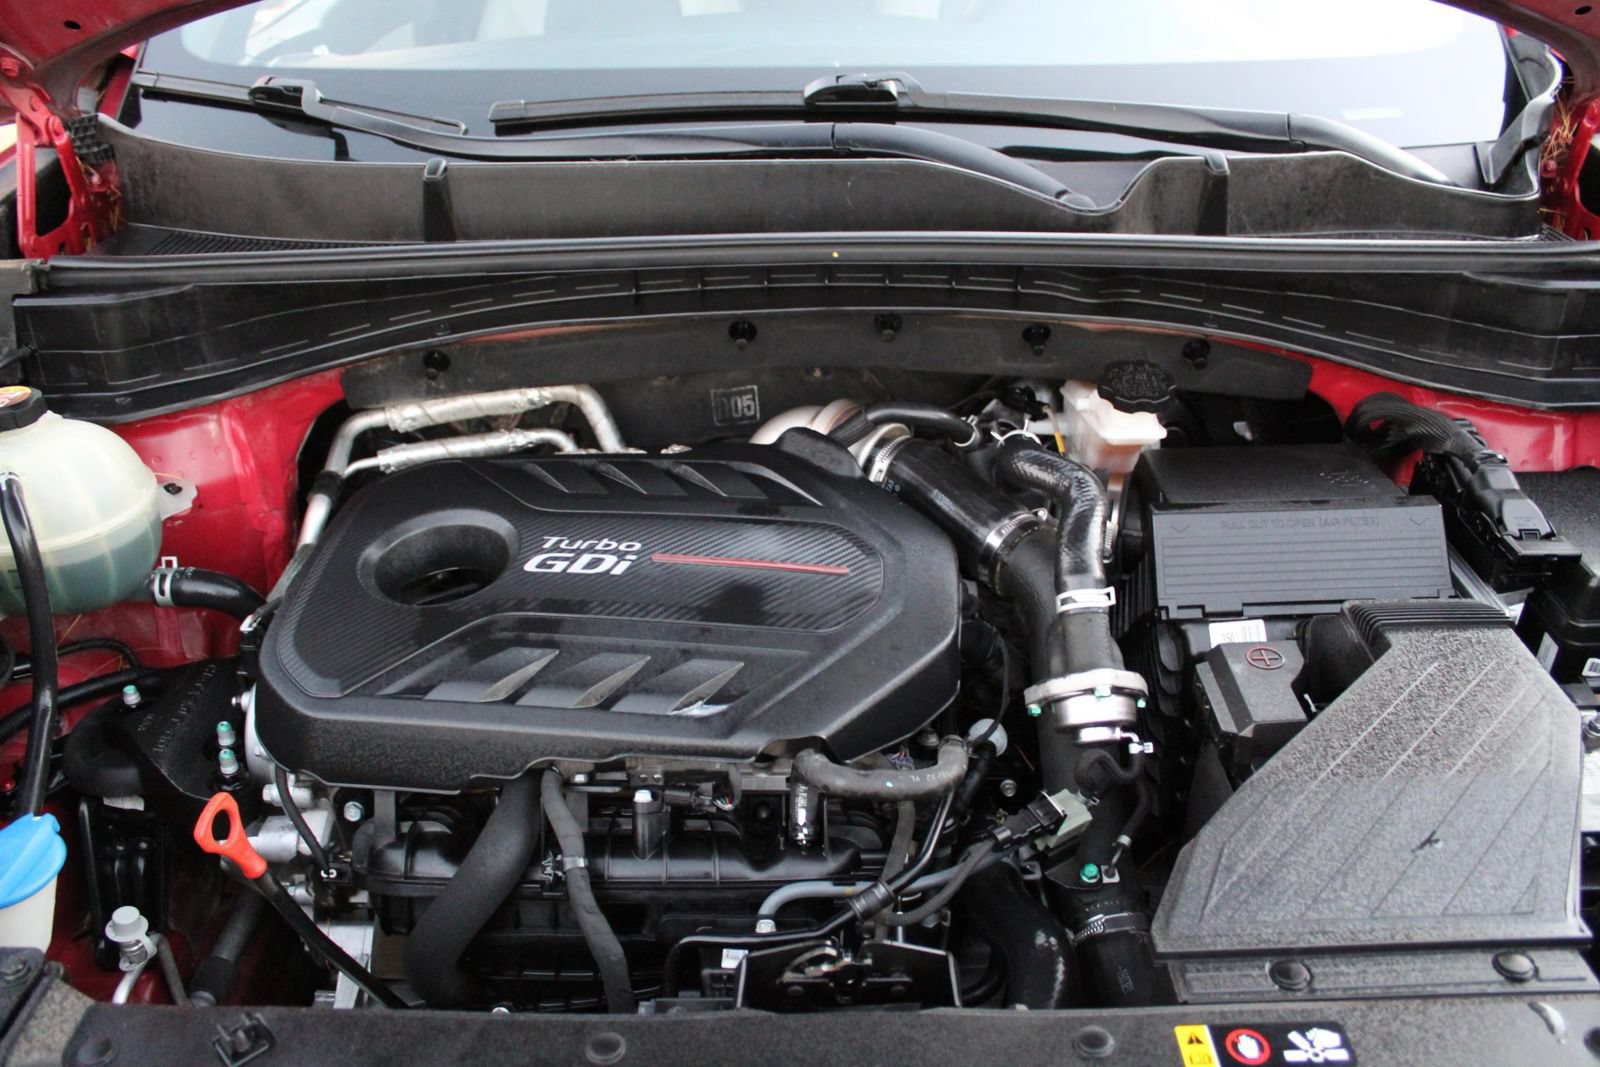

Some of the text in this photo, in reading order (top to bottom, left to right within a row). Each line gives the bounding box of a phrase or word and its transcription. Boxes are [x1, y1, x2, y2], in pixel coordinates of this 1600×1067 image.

[1248, 519, 1268, 529] OUT
[1271, 518, 1286, 529] TO
[1286, 517, 1315, 528] OPEN
[542, 536, 642, 551] Turbo
[523, 552, 638, 575] GDi
